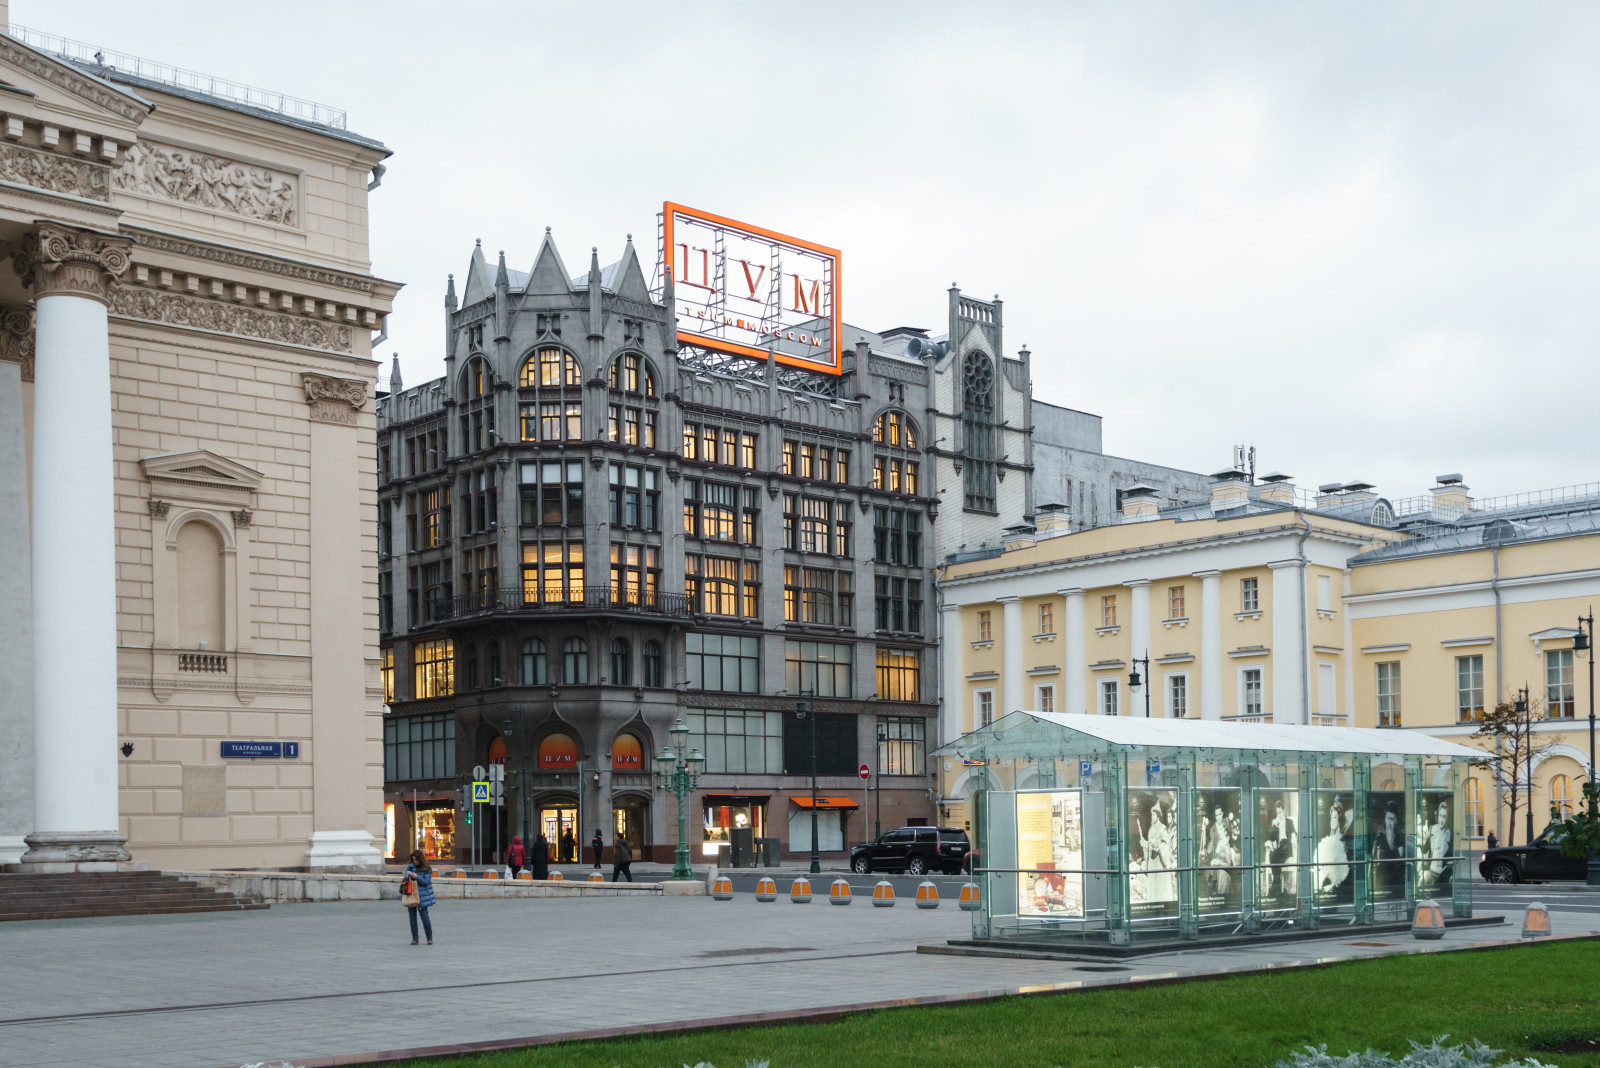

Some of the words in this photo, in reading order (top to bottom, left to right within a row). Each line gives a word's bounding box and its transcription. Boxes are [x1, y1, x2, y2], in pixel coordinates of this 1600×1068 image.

[681, 243, 826, 318] ЦУМ
[684, 306, 733, 326] TSUM
[746, 321, 822, 346] MOSCOW
[289, 744, 294, 755] 1
[1081, 762, 1090, 775] P
